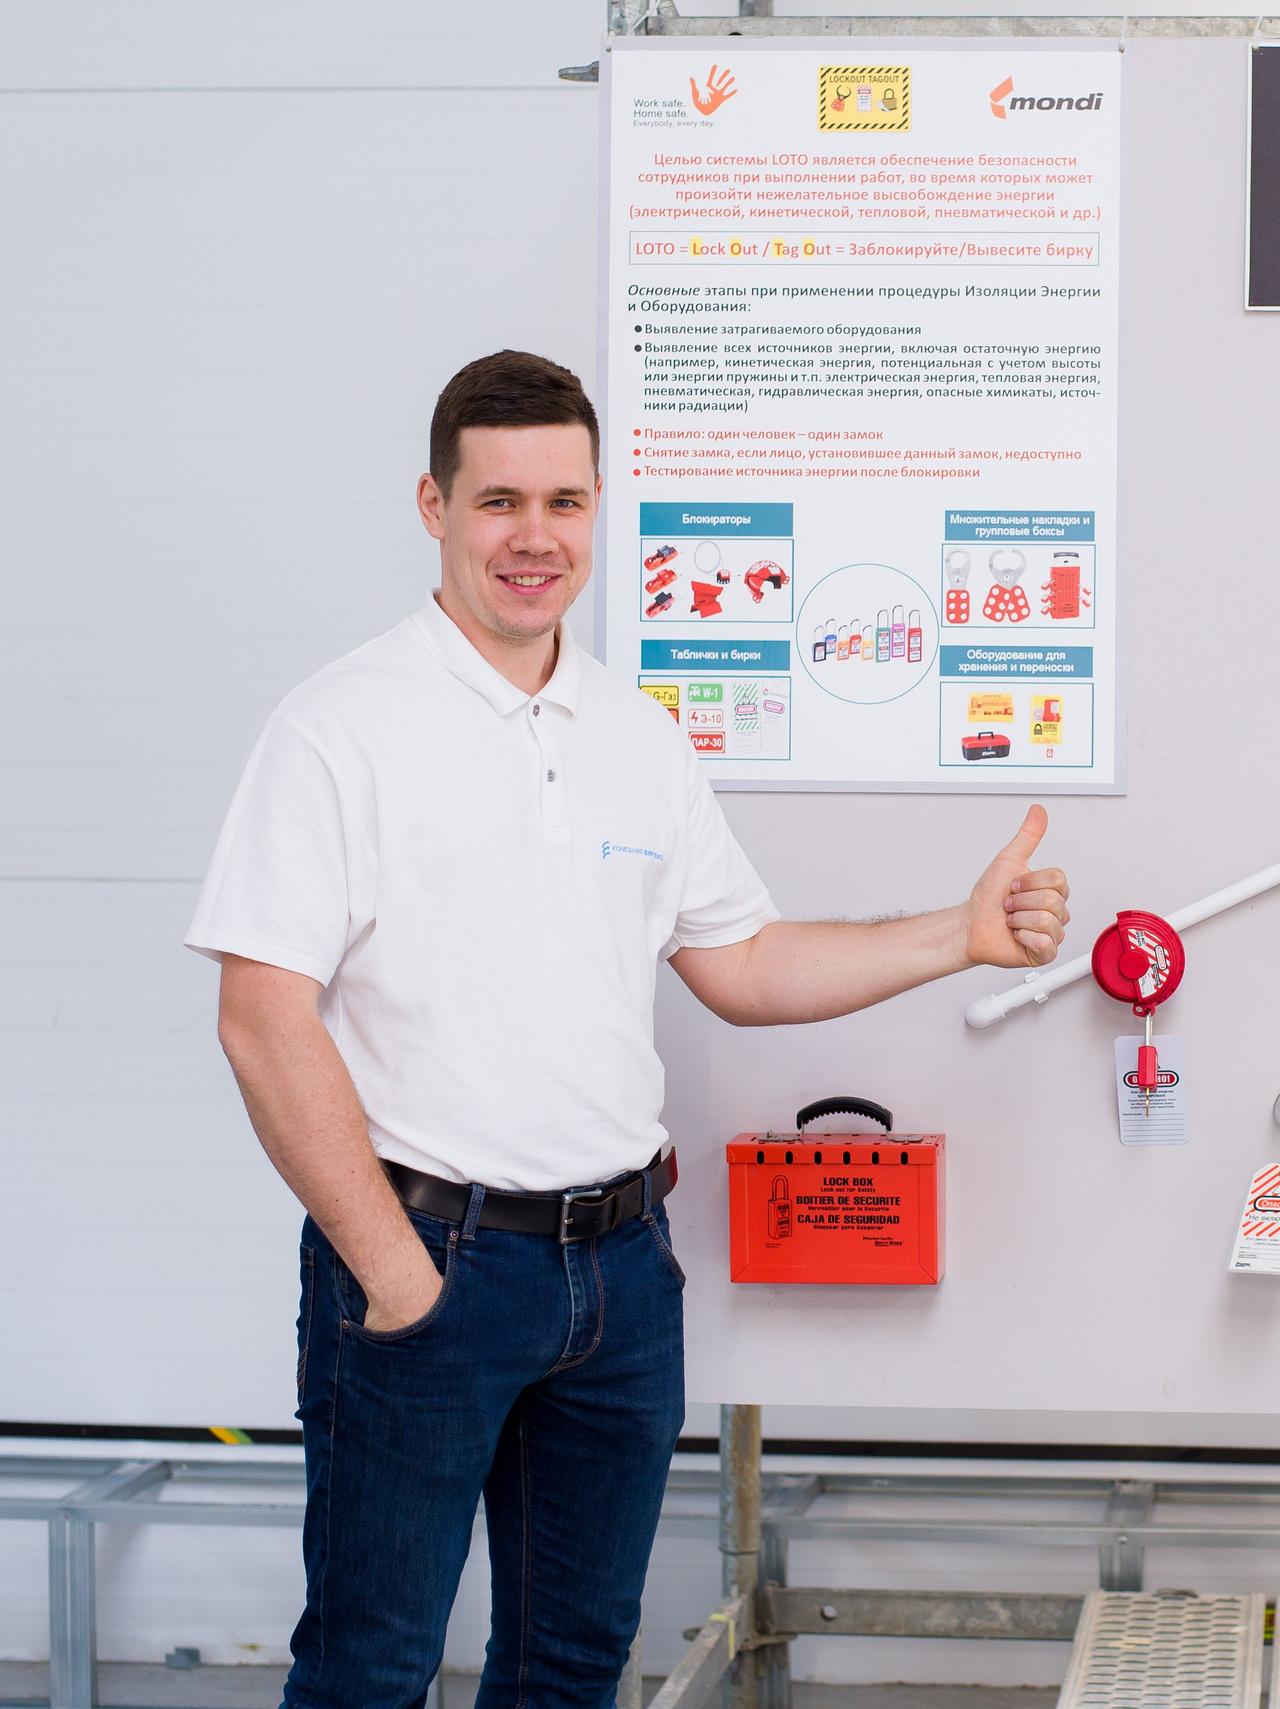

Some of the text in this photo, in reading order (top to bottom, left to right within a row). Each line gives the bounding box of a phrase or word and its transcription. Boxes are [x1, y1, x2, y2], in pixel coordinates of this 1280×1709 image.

[829, 74, 864, 82] LOCKOUT
[1009, 92, 1103, 110] mondi
[655, 154, 1076, 167] Целью системы LOTO является обеспечение безопасности
[638, 174, 1092, 185] сотрудников при выполнении работ, во время которых может
[676, 188, 1054, 203] произойти нежелательное высвобождение энергии
[630, 205, 744, 220] (электрической,
[750, 206, 853, 219] кинетической,
[858, 206, 930, 220] тепловой,
[936, 206, 1054, 218] пневматической
[1073, 206, 1100, 220] др.)
[636, 243, 674, 255] LOTO
[693, 242, 725, 255] Lock
[730, 243, 758, 255] Out
[774, 243, 799, 258] Tag
[804, 243, 831, 255] Out
[850, 242, 1041, 258] Заблокируйте/Вывесите
[1047, 243, 1092, 259] бирку
[628, 285, 1100, 299] Основные этапы при применении процедуры Изоляции Энергии
[641, 300, 750, 314] Оборудования:
[646, 324, 921, 337] Выявление затрагиваемого оборудования
[645, 342, 717, 352] Выявление
[839, 345, 894, 355] энергии,
[964, 346, 1039, 356] остаточную
[1046, 346, 1100, 356] энергию
[679, 400, 748, 413] радиации)
[645, 428, 704, 441] Правило:
[708, 431, 740, 441] один
[808, 432, 840, 441] один
[644, 447, 689, 457] Снятие
[692, 450, 734, 459] замка,
[770, 450, 805, 460] лицо,
[808, 450, 901, 460] установившее
[904, 448, 955, 460] данный
[959, 451, 1002, 460] замок,
[1006, 451, 1081, 461] недоступно
[644, 466, 733, 478] Тестирование
[806, 469, 857, 479] энергии
[901, 466, 980, 480] блокировки
[682, 514, 750, 526] Блокираторы
[949, 514, 1029, 525] Множительные
[1032, 517, 1080, 526] накладки
[976, 526, 1064, 538] групповые боксы
[670, 650, 718, 659] Таблички
[731, 650, 760, 662] бирки
[966, 650, 1066, 662] Оборудование для
[958, 663, 1007, 673] хранения
[1020, 664, 1074, 674] переноски
[703, 687, 718, 698] W-1
[701, 714, 722, 724] Э-10
[823, 1177, 873, 1186] LOCK BOX
[796, 1196, 900, 1205] BOITIER DE SECURITE
[797, 1214, 900, 1224] CAJA DE SEGURIDAD
